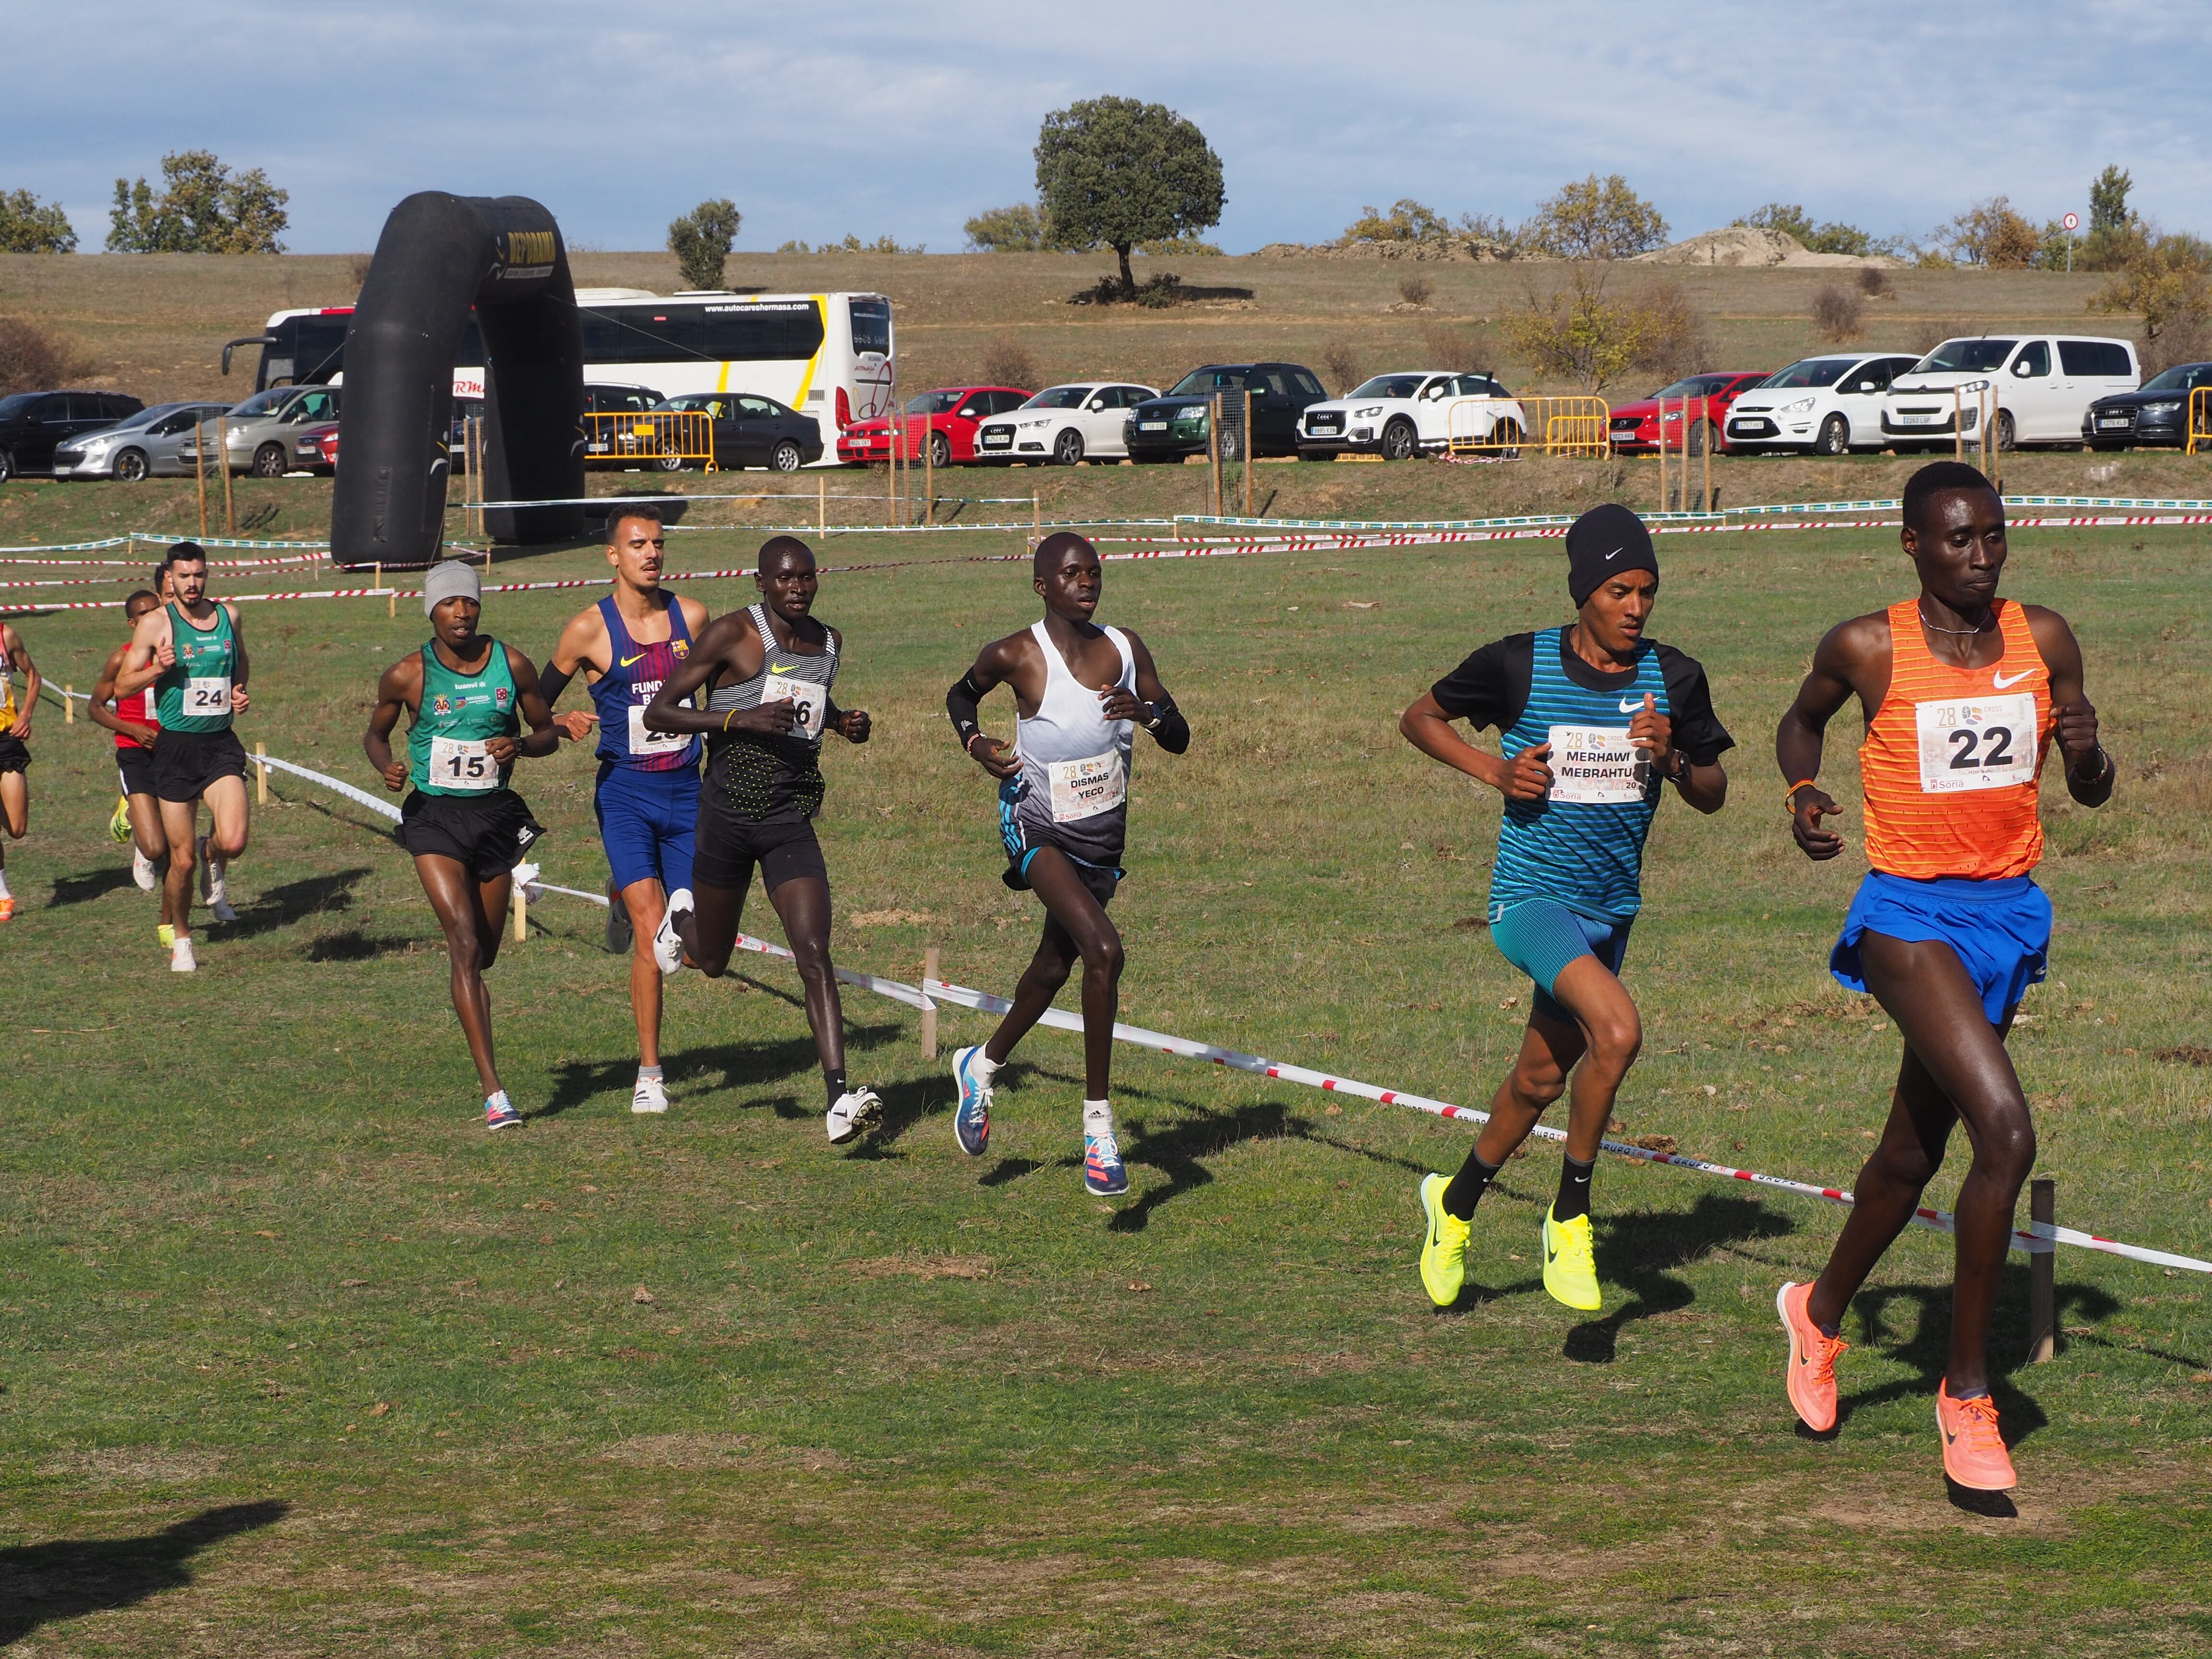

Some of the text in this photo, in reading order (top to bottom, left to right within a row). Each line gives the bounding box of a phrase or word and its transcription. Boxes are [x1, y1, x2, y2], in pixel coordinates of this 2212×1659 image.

[705, 303, 809, 313] www.autocareshermasa.com
[632, 680, 666, 694] FUND
[777, 682, 788, 695] 28
[195, 690, 222, 706] 24
[642, 693, 656, 705] B
[795, 700, 811, 725] 6
[1937, 707, 1956, 726] 28
[1566, 732, 1583, 748] 28
[443, 742, 454, 754] 28
[1948, 727, 2013, 769] 22
[1566, 751, 1630, 762] MERHAWI
[447, 756, 484, 778] 15
[1063, 766, 1077, 779] 28
[1561, 767, 1632, 778] MEBRAHTU
[1071, 772, 1109, 788] DISMAS
[1078, 786, 1104, 799] YECO
